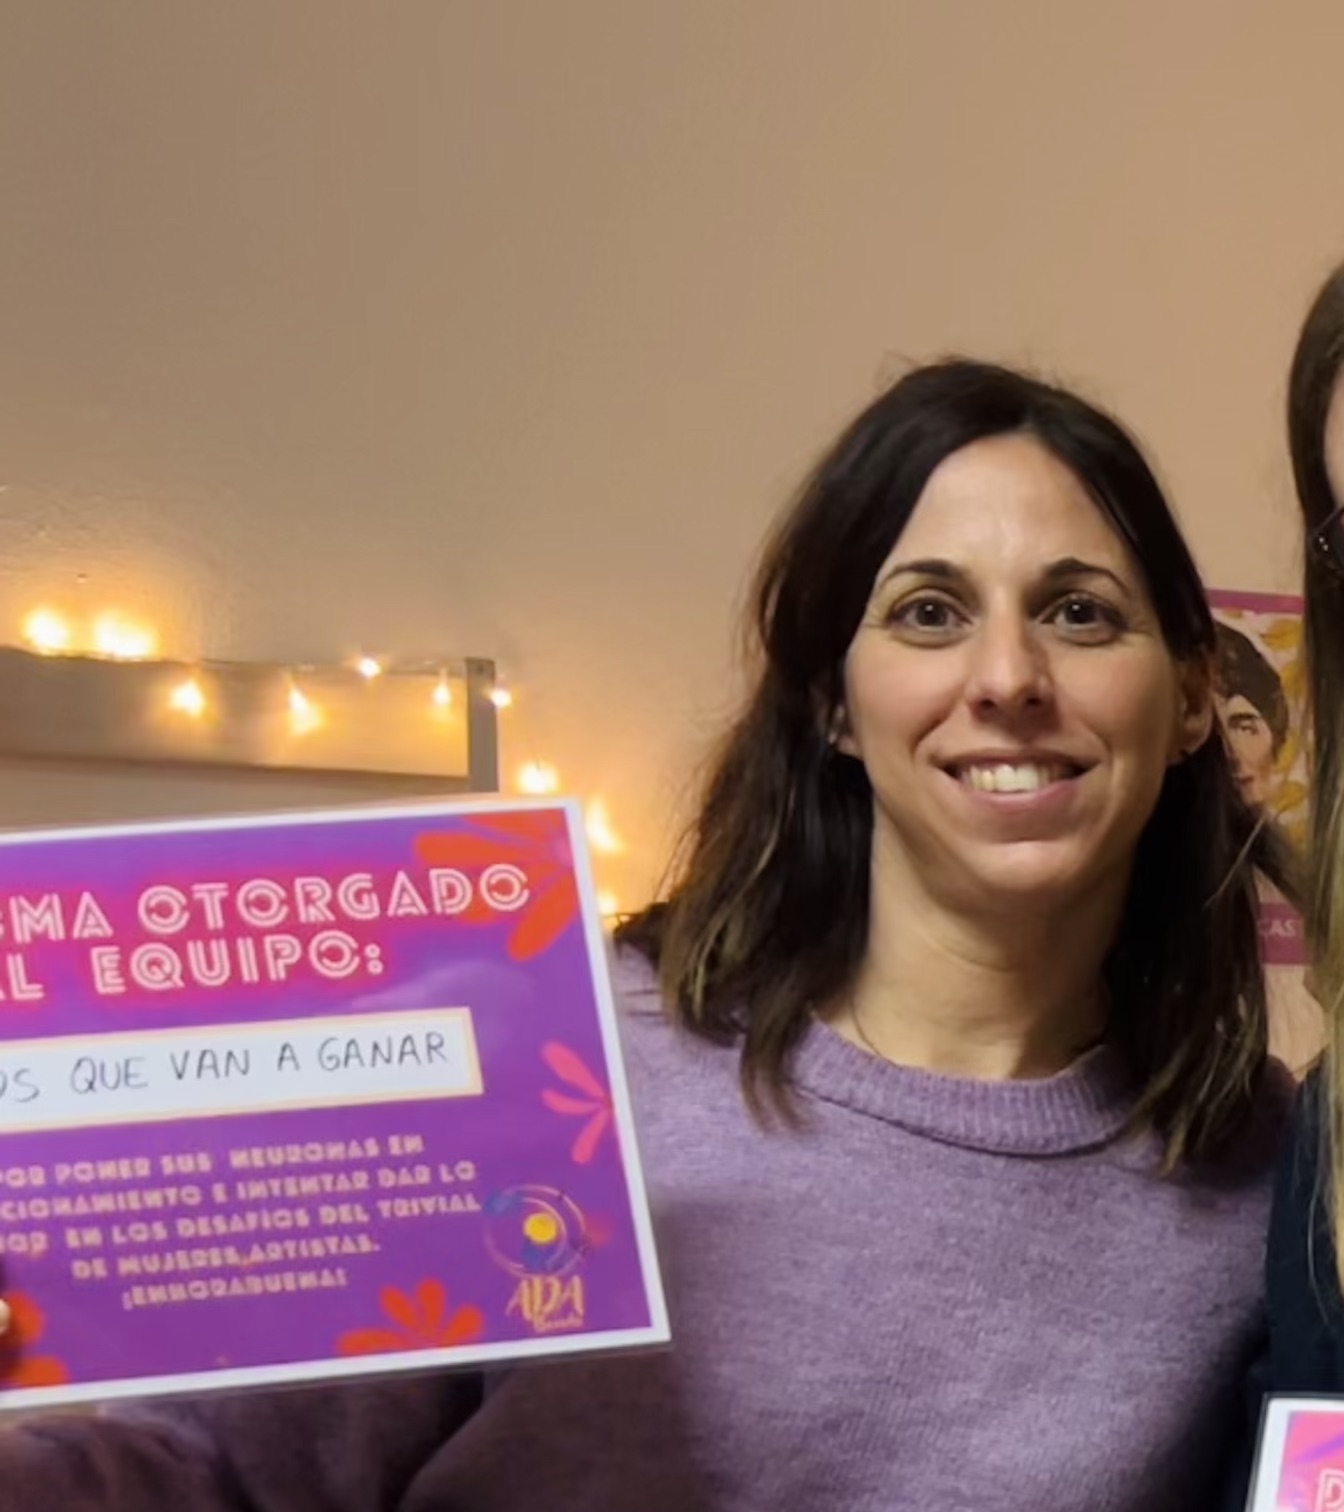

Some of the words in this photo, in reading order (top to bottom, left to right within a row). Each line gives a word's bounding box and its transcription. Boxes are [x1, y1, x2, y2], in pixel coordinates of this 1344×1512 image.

[137, 862, 529, 935] OTORGADO
[90, 929, 383, 995] EQUIPO:
[70, 1056, 148, 1094] QUE
[169, 1048, 250, 1080] VAN
[276, 1041, 300, 1071] A
[317, 1031, 446, 1071] GANAR
[0, 1185, 202, 1222] CIONAMIENTO
